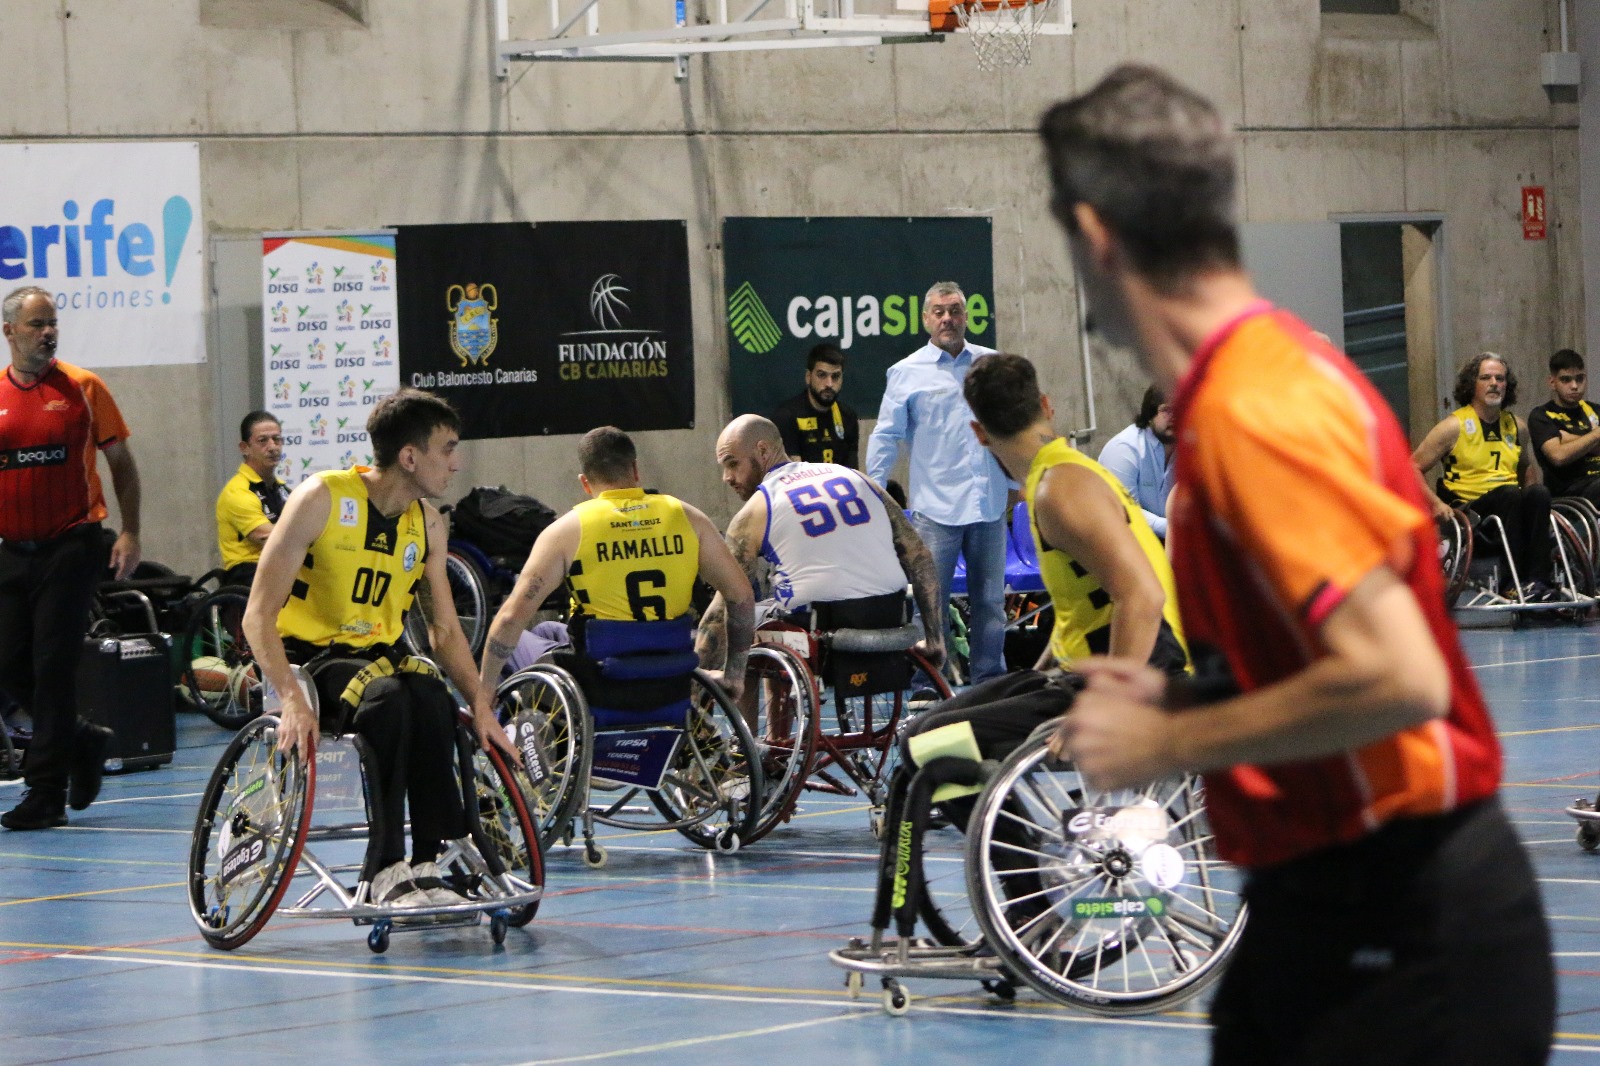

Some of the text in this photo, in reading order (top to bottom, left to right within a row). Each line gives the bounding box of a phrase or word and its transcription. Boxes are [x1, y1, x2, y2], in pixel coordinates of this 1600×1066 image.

[787, 293, 989, 350] cajasie
[558, 337, 667, 362] FUNDACIÓN
[412, 368, 538, 388] Club Baloncesto Canarias
[559, 360, 668, 381] CB CANARIAS
[1490, 451, 1501, 470] 7
[785, 476, 871, 537] 58
[596, 534, 684, 562] RAMALLO
[626, 570, 666, 622] 6
[616, 739, 648, 747] TIPSA
[523, 735, 543, 780] Egatesa
[223, 847, 252, 877] Egatesa
[1076, 898, 1146, 915] cajasiete
